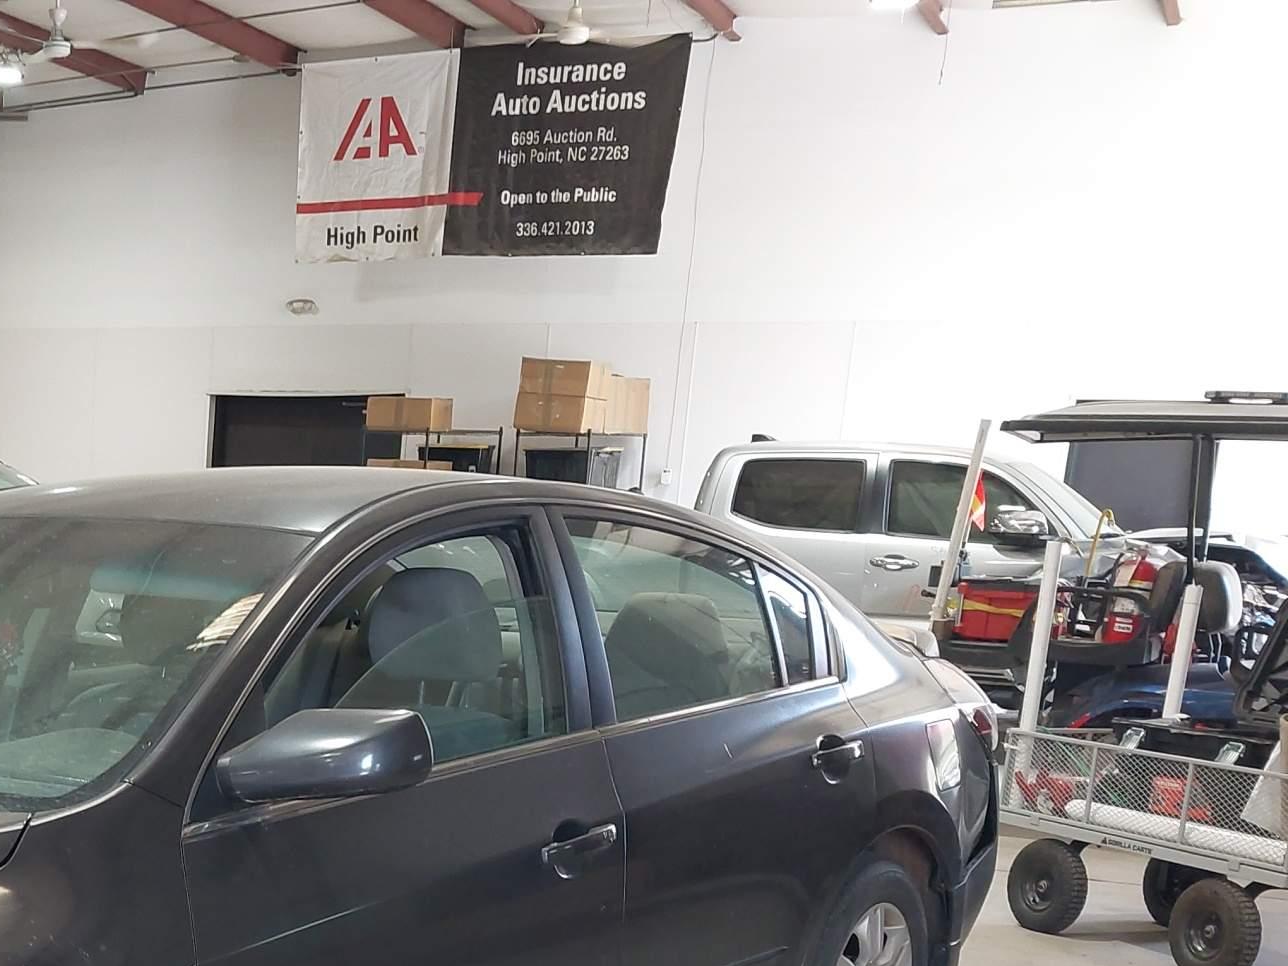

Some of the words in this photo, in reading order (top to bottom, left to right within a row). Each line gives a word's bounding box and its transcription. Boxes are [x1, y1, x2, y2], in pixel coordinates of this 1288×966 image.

[516, 61, 626, 86] Insurance
[491, 92, 541, 117] Auto
[546, 88, 646, 114] Auctions
[511, 131, 540, 146] 6695
[544, 129, 593, 144] Auction
[597, 127, 617, 143] Rd.
[498, 149, 526, 165] High
[529, 148, 564, 164] Point,
[568, 147, 586, 162] NC
[590, 145, 630, 161] 27263
[501, 191, 532, 207] Open
[535, 190, 547, 204] to
[551, 189, 570, 203] the
[574, 187, 616, 203] Public
[327, 226, 366, 250] High
[373, 224, 419, 244] Point
[515, 221, 594, 237] 336.421.2013
